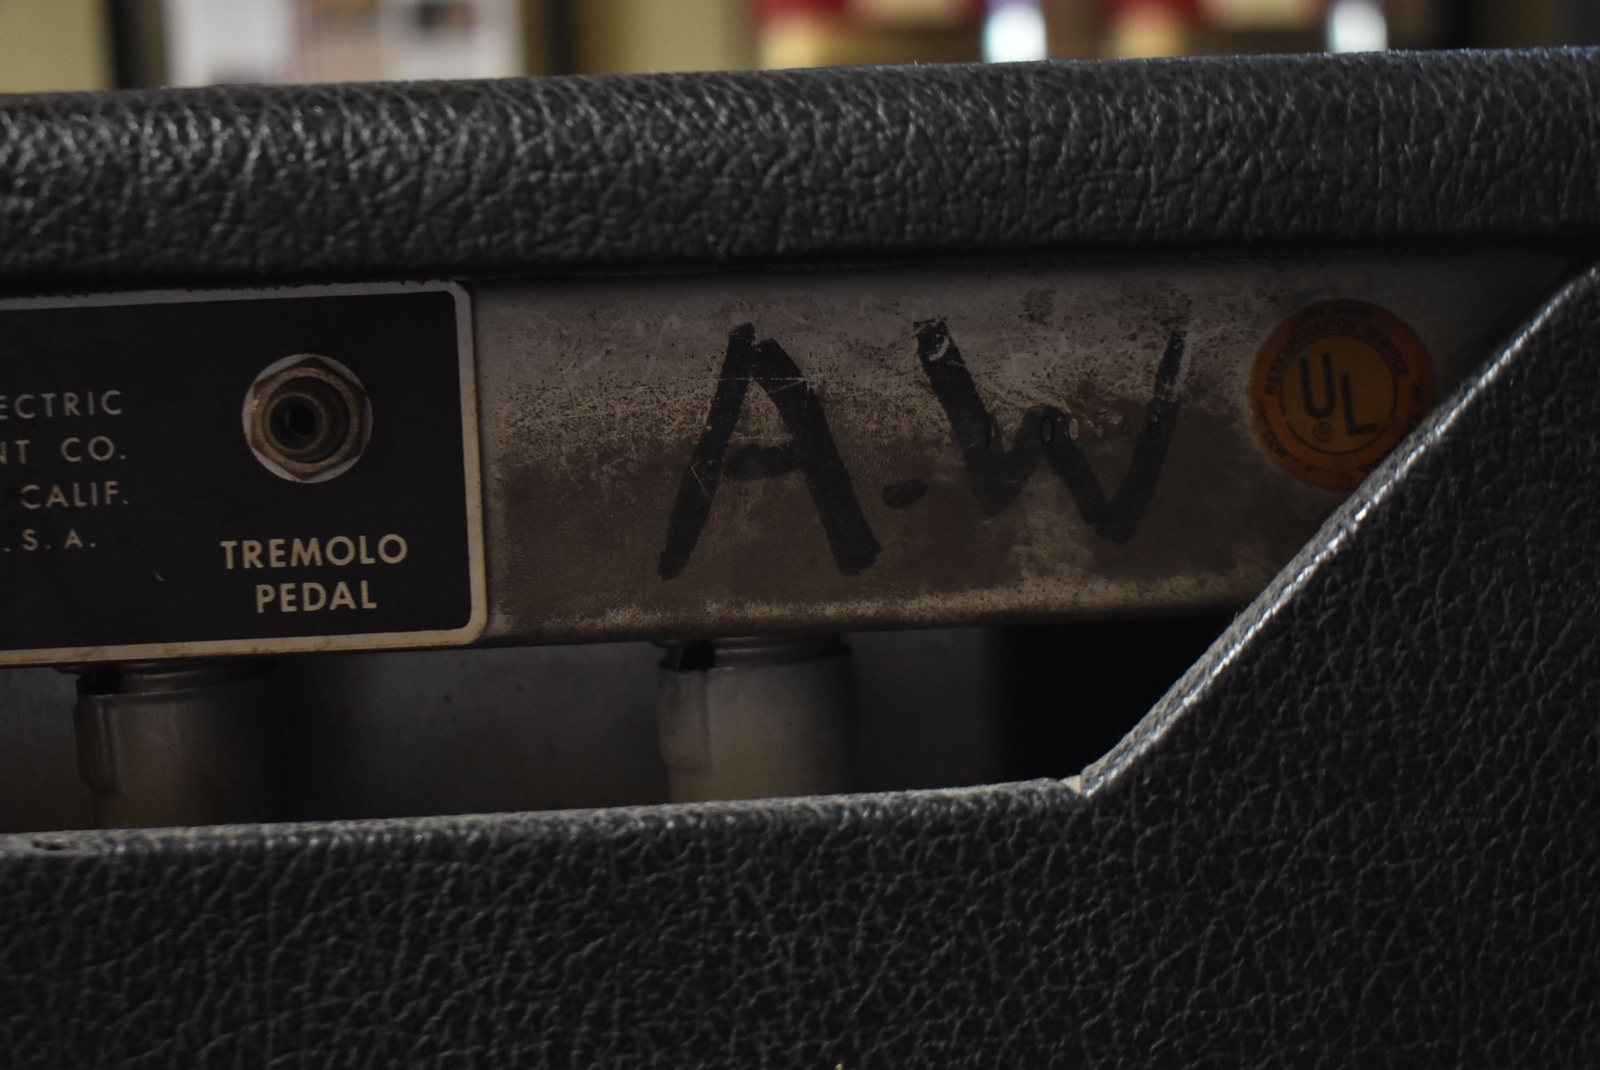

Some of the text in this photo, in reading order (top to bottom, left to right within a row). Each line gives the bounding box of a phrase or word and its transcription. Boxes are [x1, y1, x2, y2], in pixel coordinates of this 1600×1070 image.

[1298, 352, 1378, 436] UL
[61, 435, 126, 462] CO.
[20, 480, 129, 509] CALIF.
[220, 534, 408, 569] TREMOLO
[255, 580, 377, 613] PEDAL
